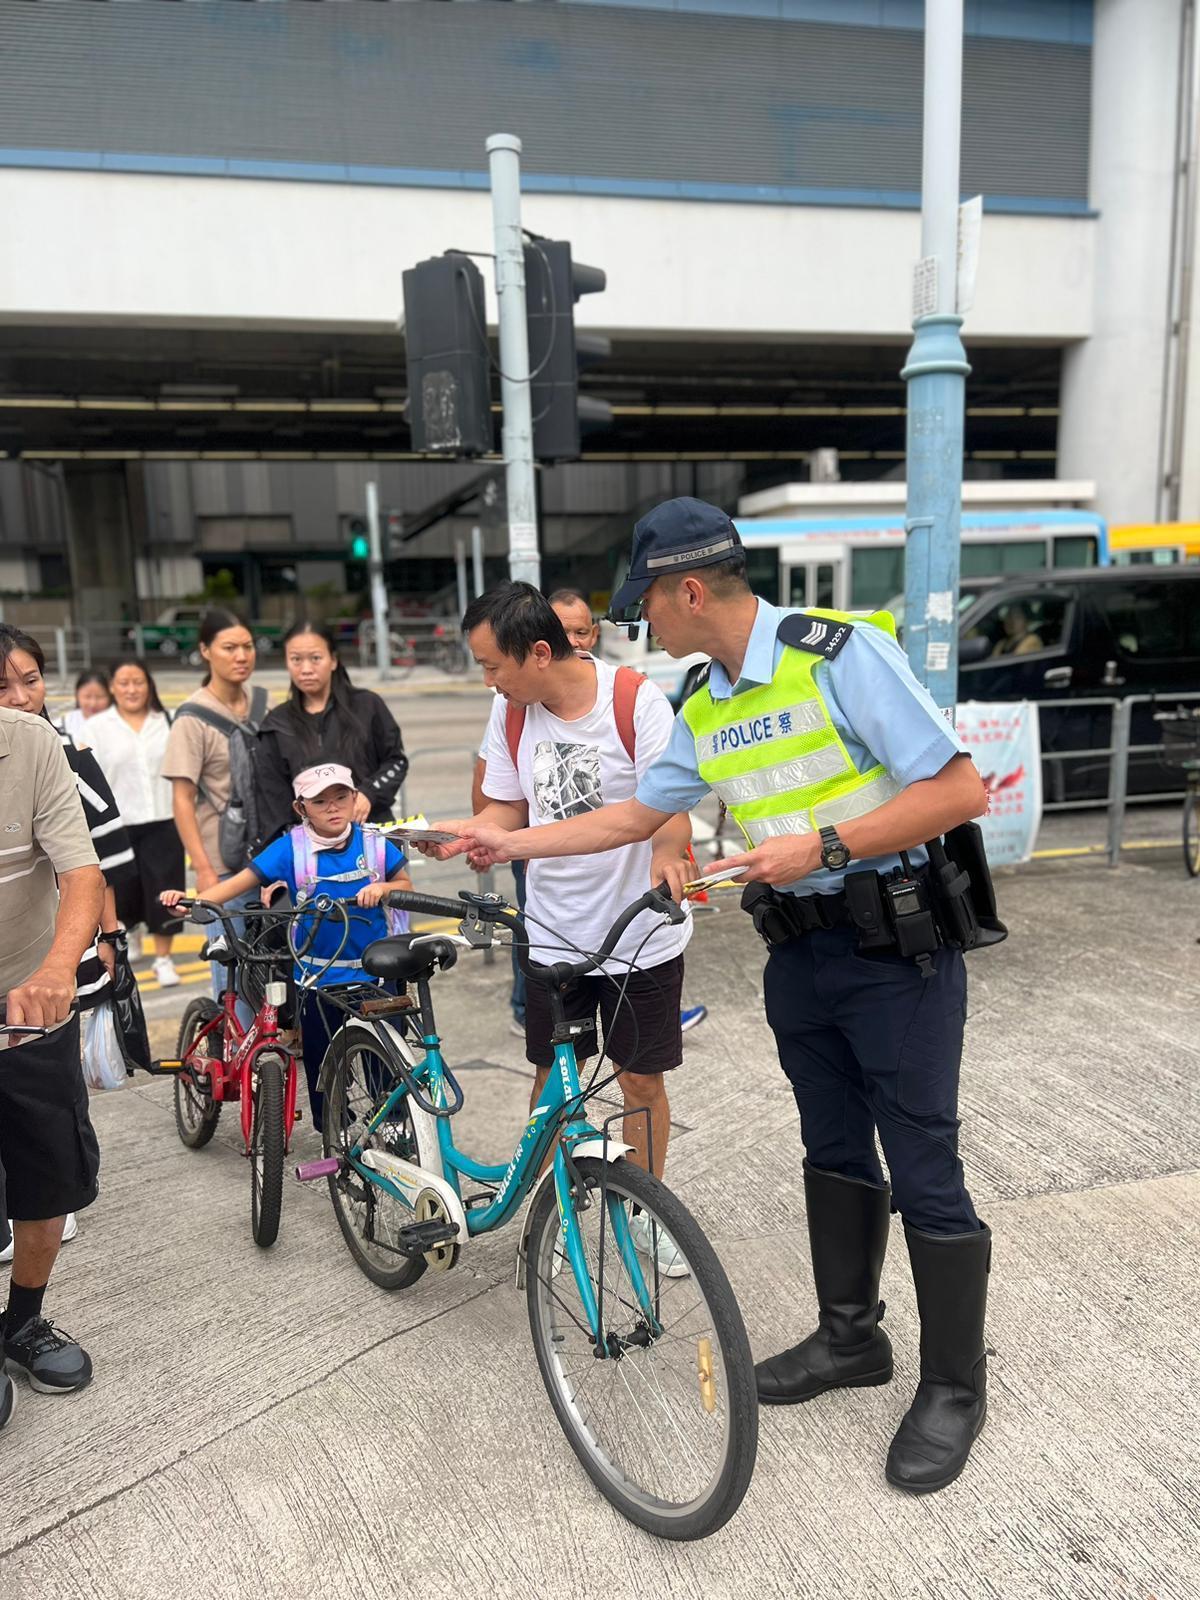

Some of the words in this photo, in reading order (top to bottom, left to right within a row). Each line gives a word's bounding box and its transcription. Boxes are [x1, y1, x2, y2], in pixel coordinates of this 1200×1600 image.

[681, 550, 706, 560] POLICE
[825, 627, 847, 652] 34292
[720, 716, 773, 750] POLICE
[778, 711, 793, 734] 察
